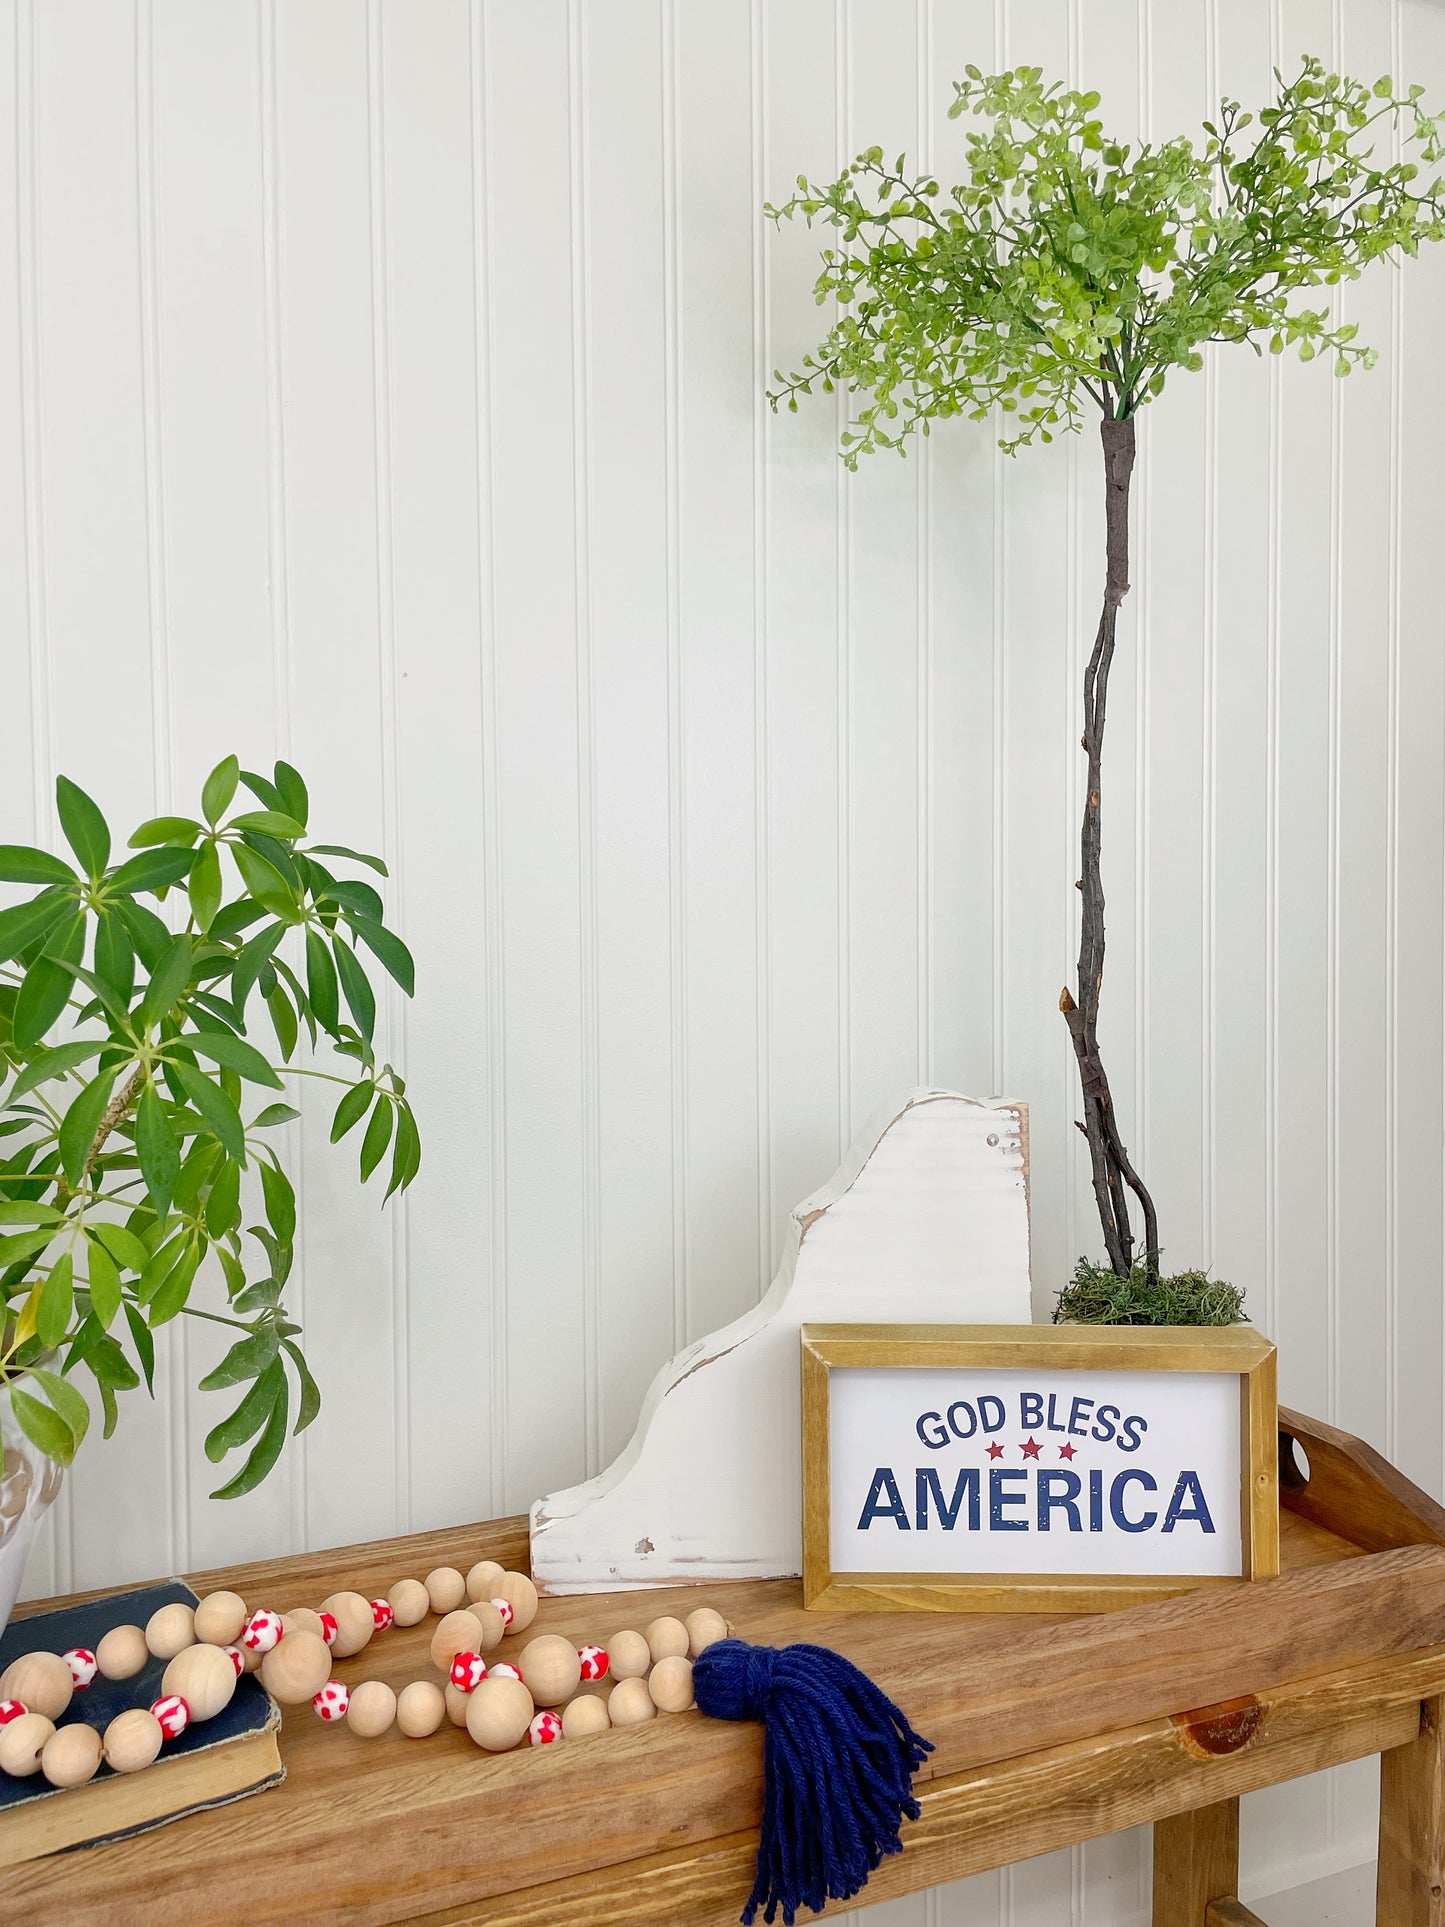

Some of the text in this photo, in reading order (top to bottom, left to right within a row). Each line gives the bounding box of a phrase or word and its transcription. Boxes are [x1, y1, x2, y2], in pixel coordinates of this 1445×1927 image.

[915, 1392, 1148, 1452] GOD BLESS
[857, 1467, 1216, 1534] AMERICA
